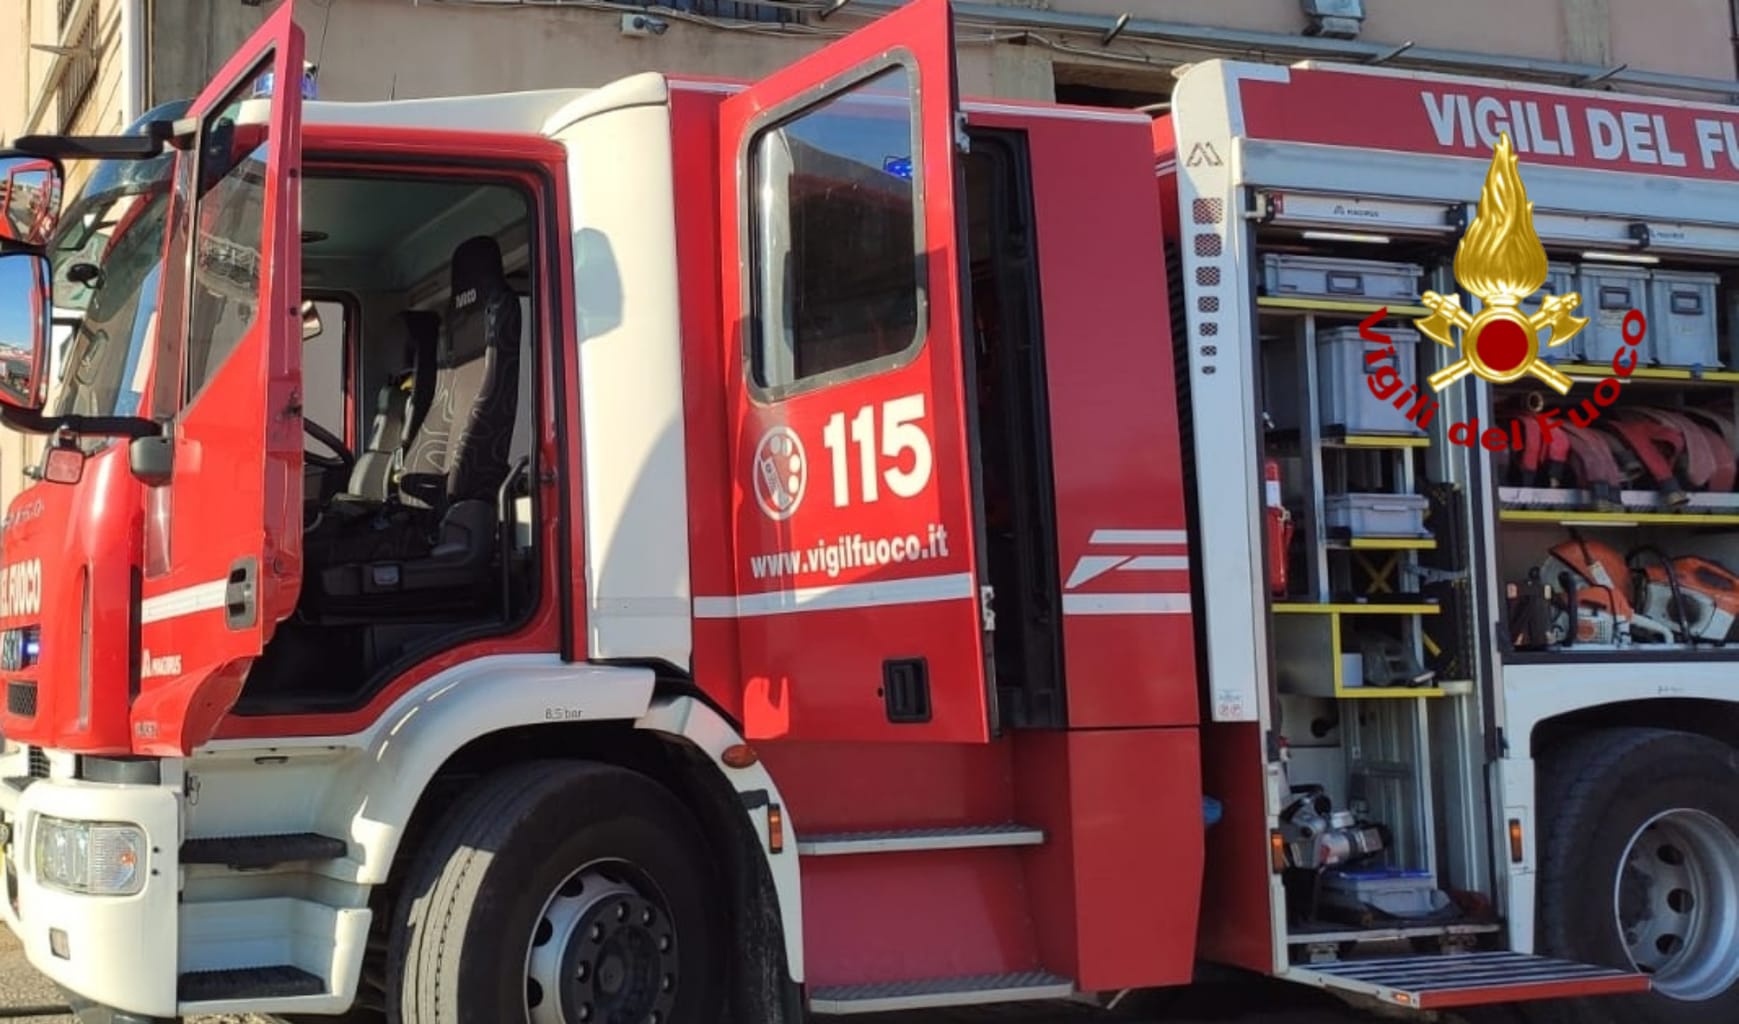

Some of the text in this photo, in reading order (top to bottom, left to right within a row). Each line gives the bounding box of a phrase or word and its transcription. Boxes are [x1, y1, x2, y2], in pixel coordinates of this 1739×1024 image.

[1421, 91, 1575, 156] VIGILI
[1585, 107, 1687, 167] DEL
[823, 393, 933, 508] 115
[750, 523, 949, 579] www.vigilfuoco.it
